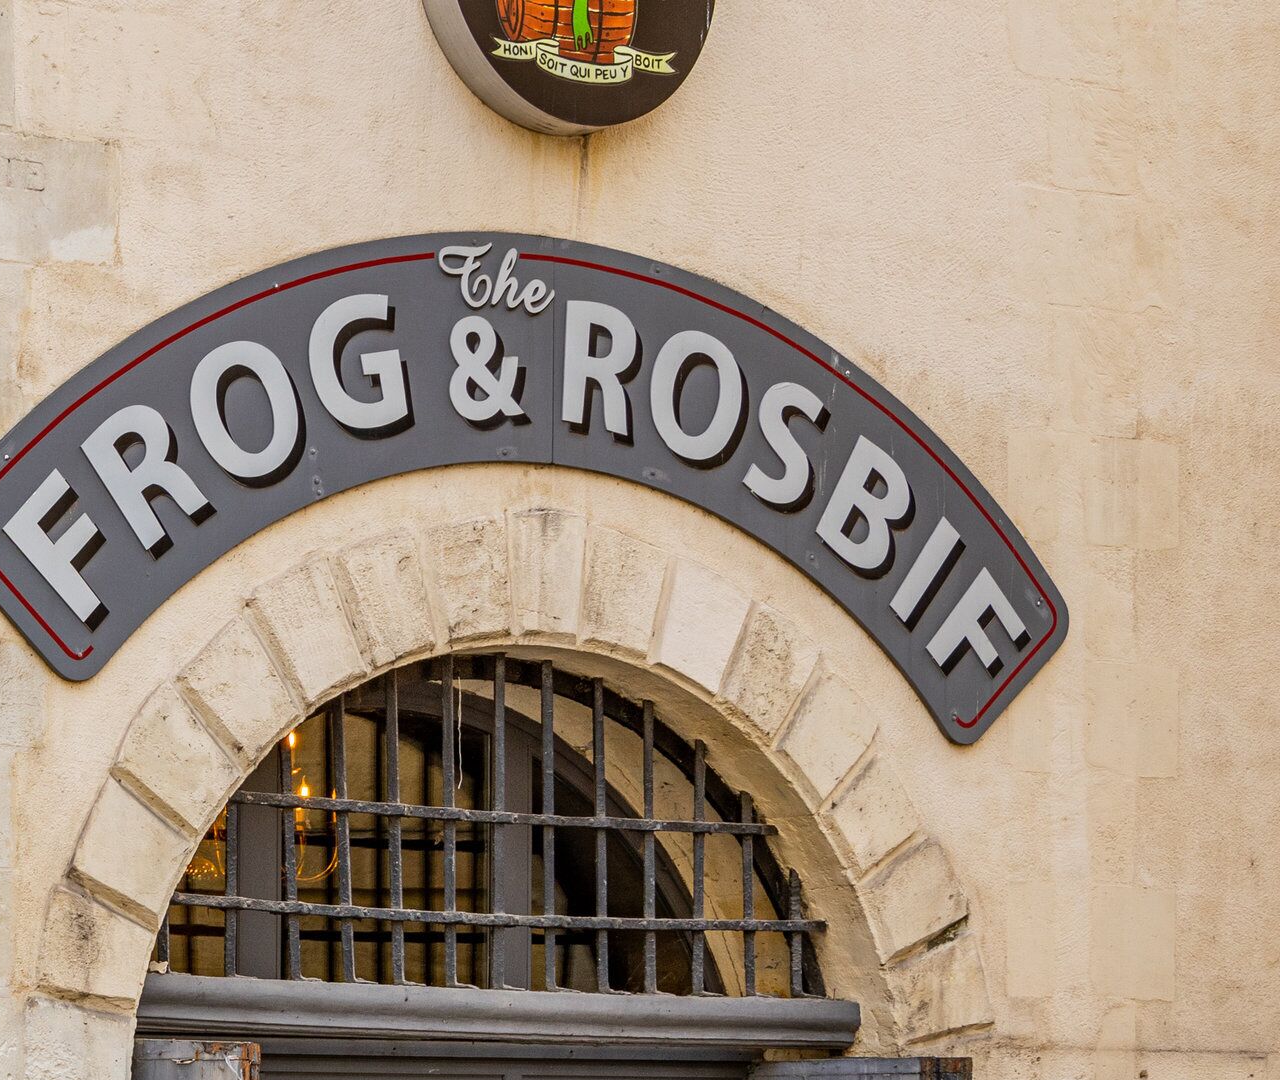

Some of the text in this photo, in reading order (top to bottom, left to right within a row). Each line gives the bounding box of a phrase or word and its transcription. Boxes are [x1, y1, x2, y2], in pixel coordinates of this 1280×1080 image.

[503, 44, 664, 80] HONI SOIT QUI PEU Y BOIT
[437, 242, 554, 314] The
[2, 293, 1032, 678] FROG & ROSBIF
